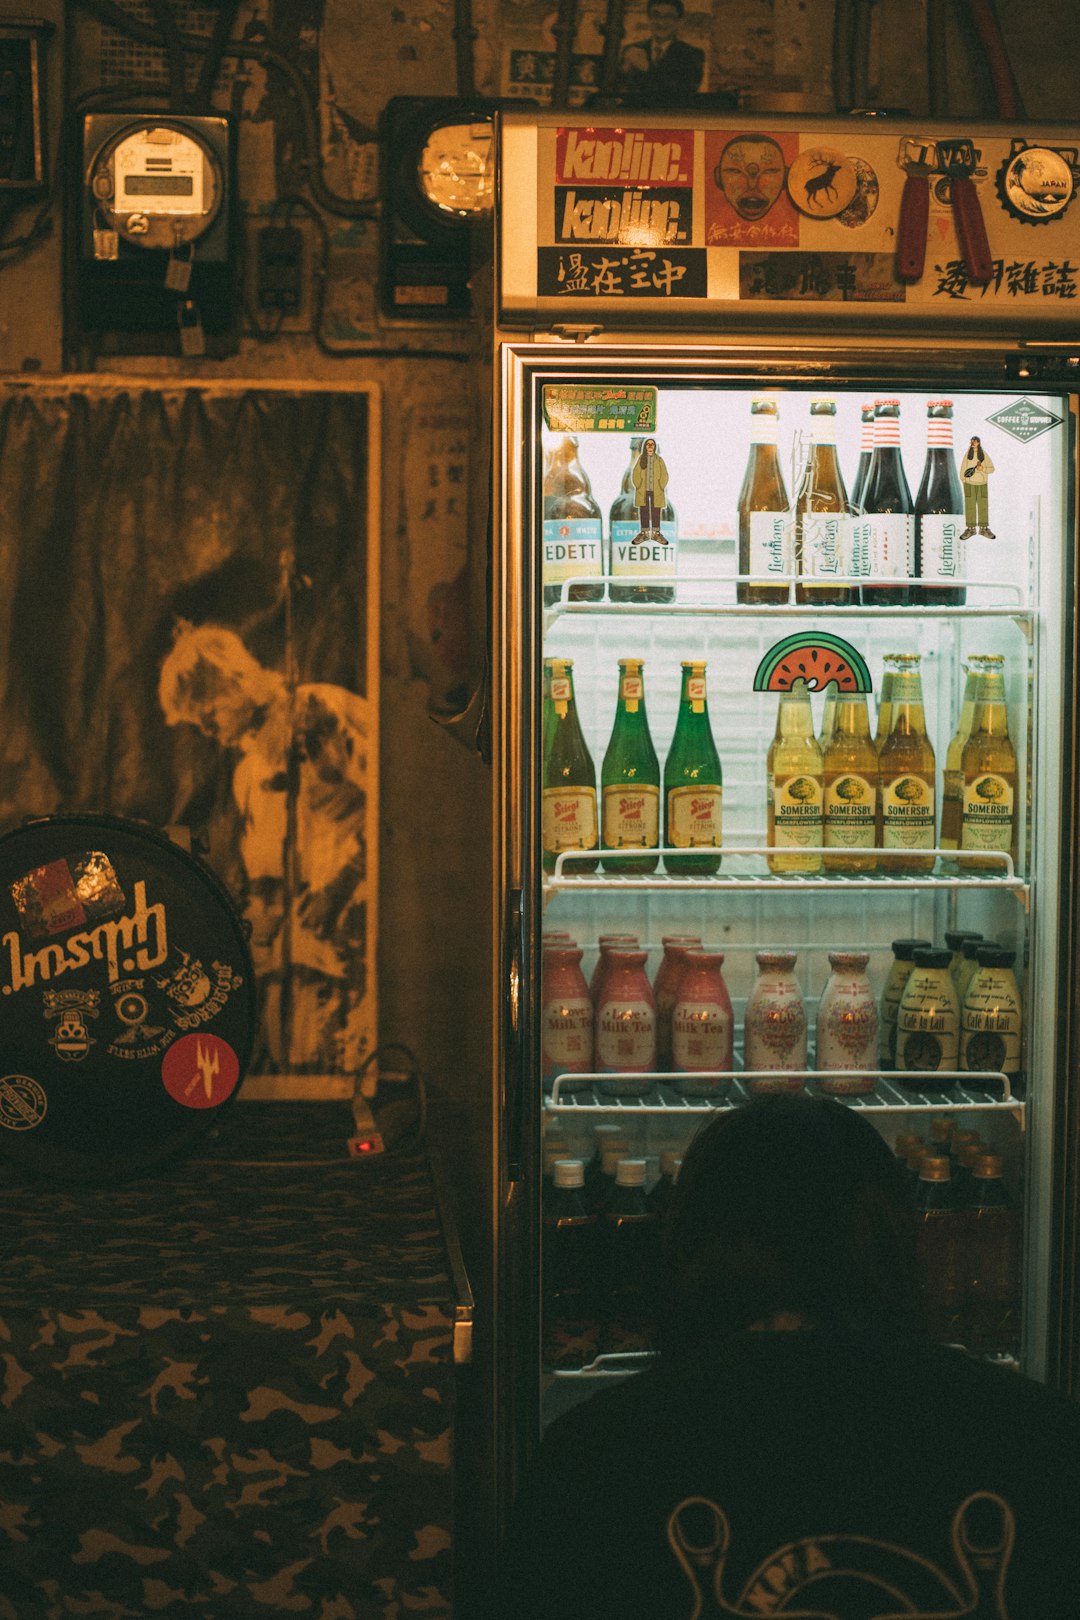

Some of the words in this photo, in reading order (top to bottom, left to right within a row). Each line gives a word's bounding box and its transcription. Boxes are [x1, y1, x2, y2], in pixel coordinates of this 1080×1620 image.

[1040, 180, 1067, 189] JAPAN
[545, 544, 597, 561] EDETT
[767, 519, 785, 574] Liefmans
[937, 523, 956, 577] Liefmans
[618, 545, 675, 563] VEDETT
[619, 799, 645, 815] Stiegl
[690, 799, 715, 815] Stiegl
[780, 804, 821, 816] SOMERSBY
[828, 804, 871, 815] SOMERSBY
[887, 804, 930, 816] SOMERSBY
[967, 803, 1009, 814] SOMERSBY
[549, 1019, 576, 1031] Milk
[601, 1020, 630, 1033] Milk
[632, 1020, 652, 1033] Tea
[702, 1022, 723, 1034] Tea
[929, 1014, 945, 1031] Lait
[996, 1013, 1010, 1031] Lait
